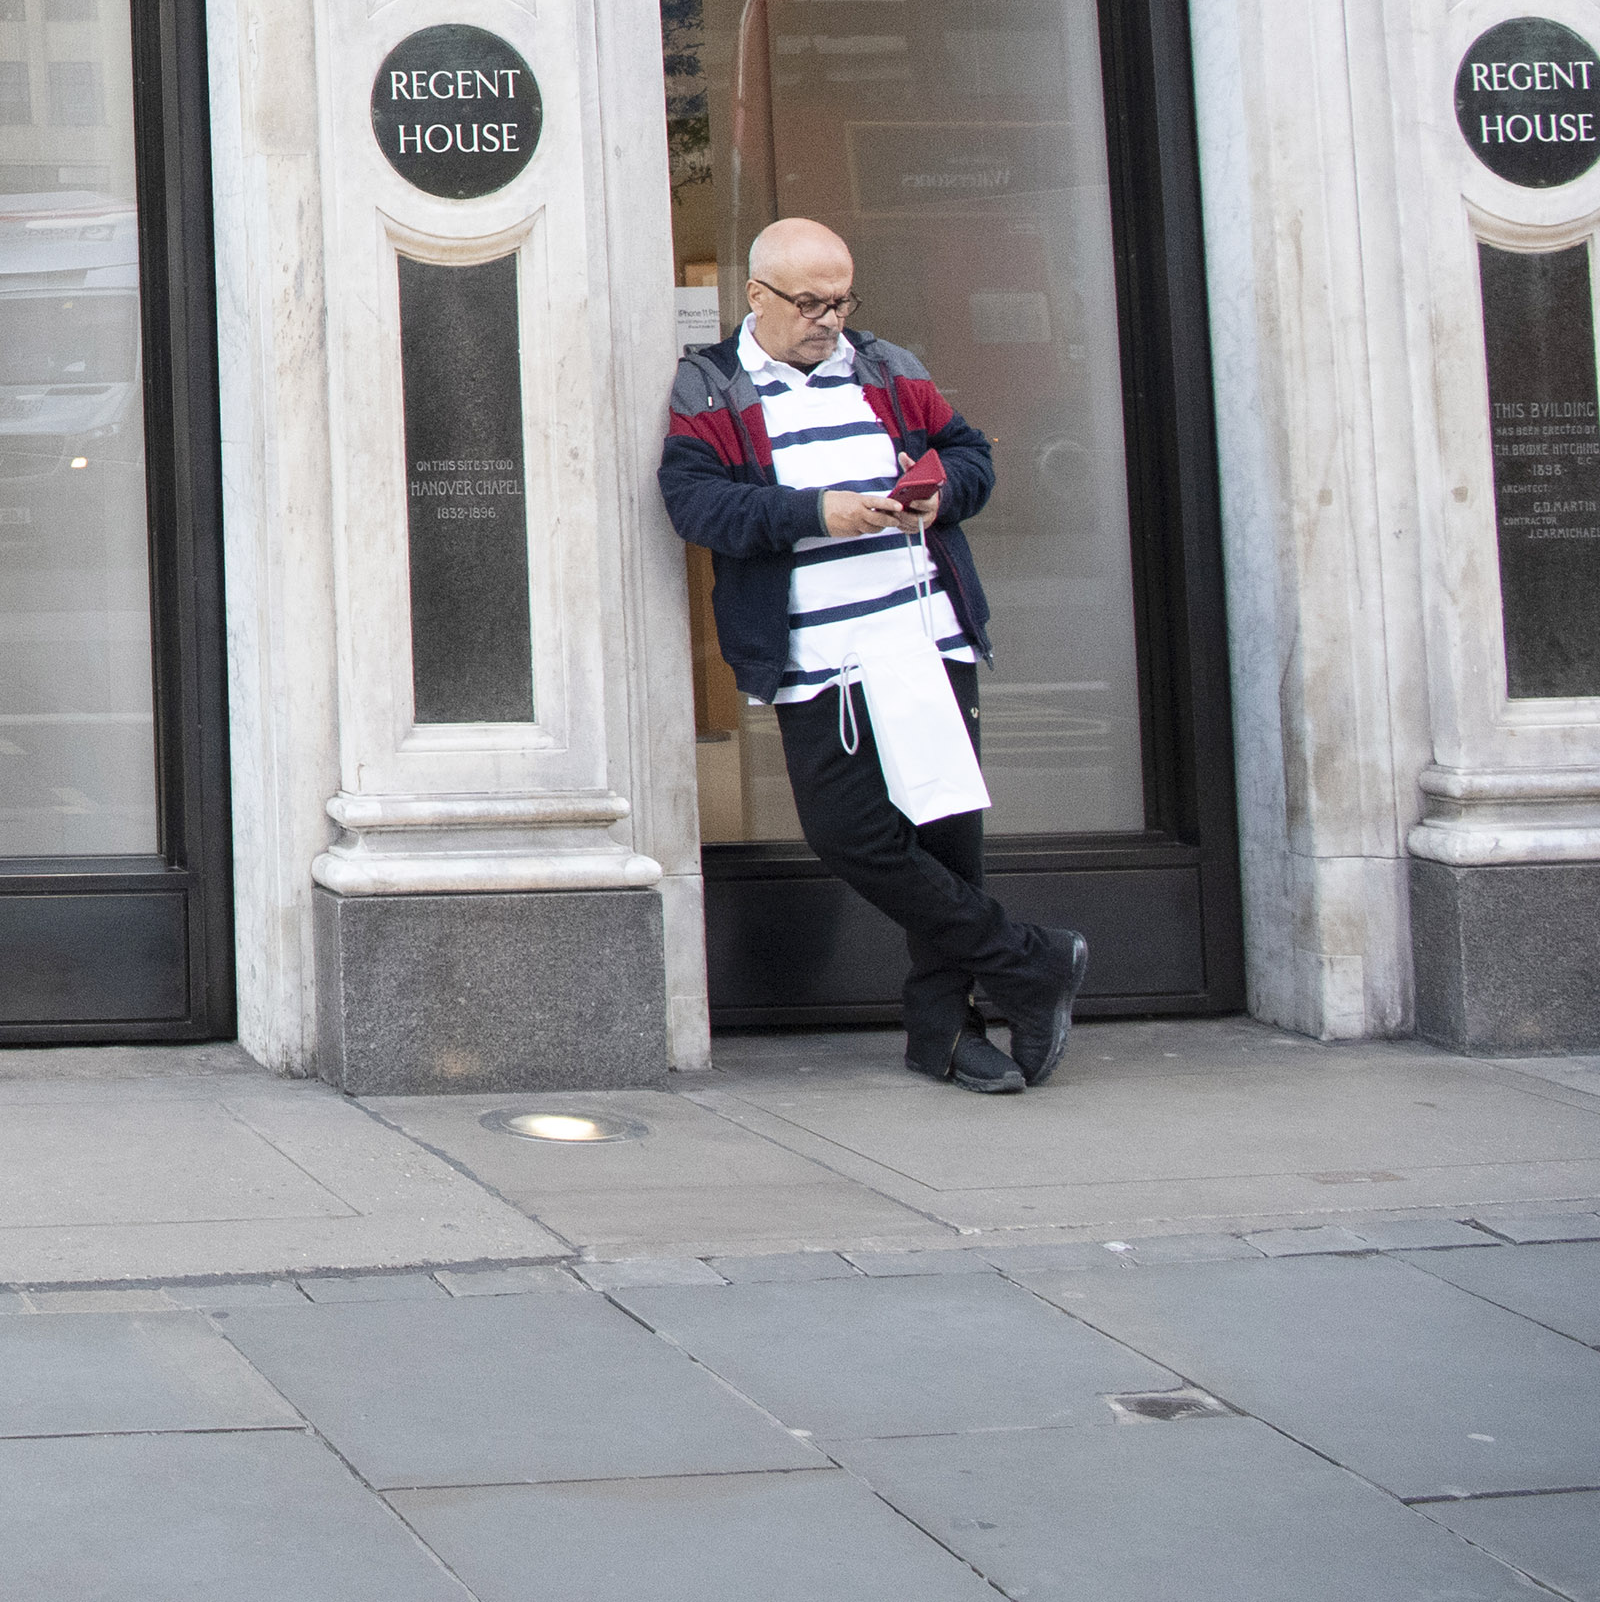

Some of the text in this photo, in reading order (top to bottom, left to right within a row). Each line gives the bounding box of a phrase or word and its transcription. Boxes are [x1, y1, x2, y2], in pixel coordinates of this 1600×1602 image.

[390, 70, 521, 100] REGENT
[1471, 61, 1594, 91] REGENT
[398, 123, 520, 154] HOUSE
[1480, 113, 1596, 143] HOUSE
[1494, 403, 1525, 418] THIS
[416, 459, 514, 471] ON THIS SITE STOOD
[411, 480, 521, 496] HANOVER CHAPEL
